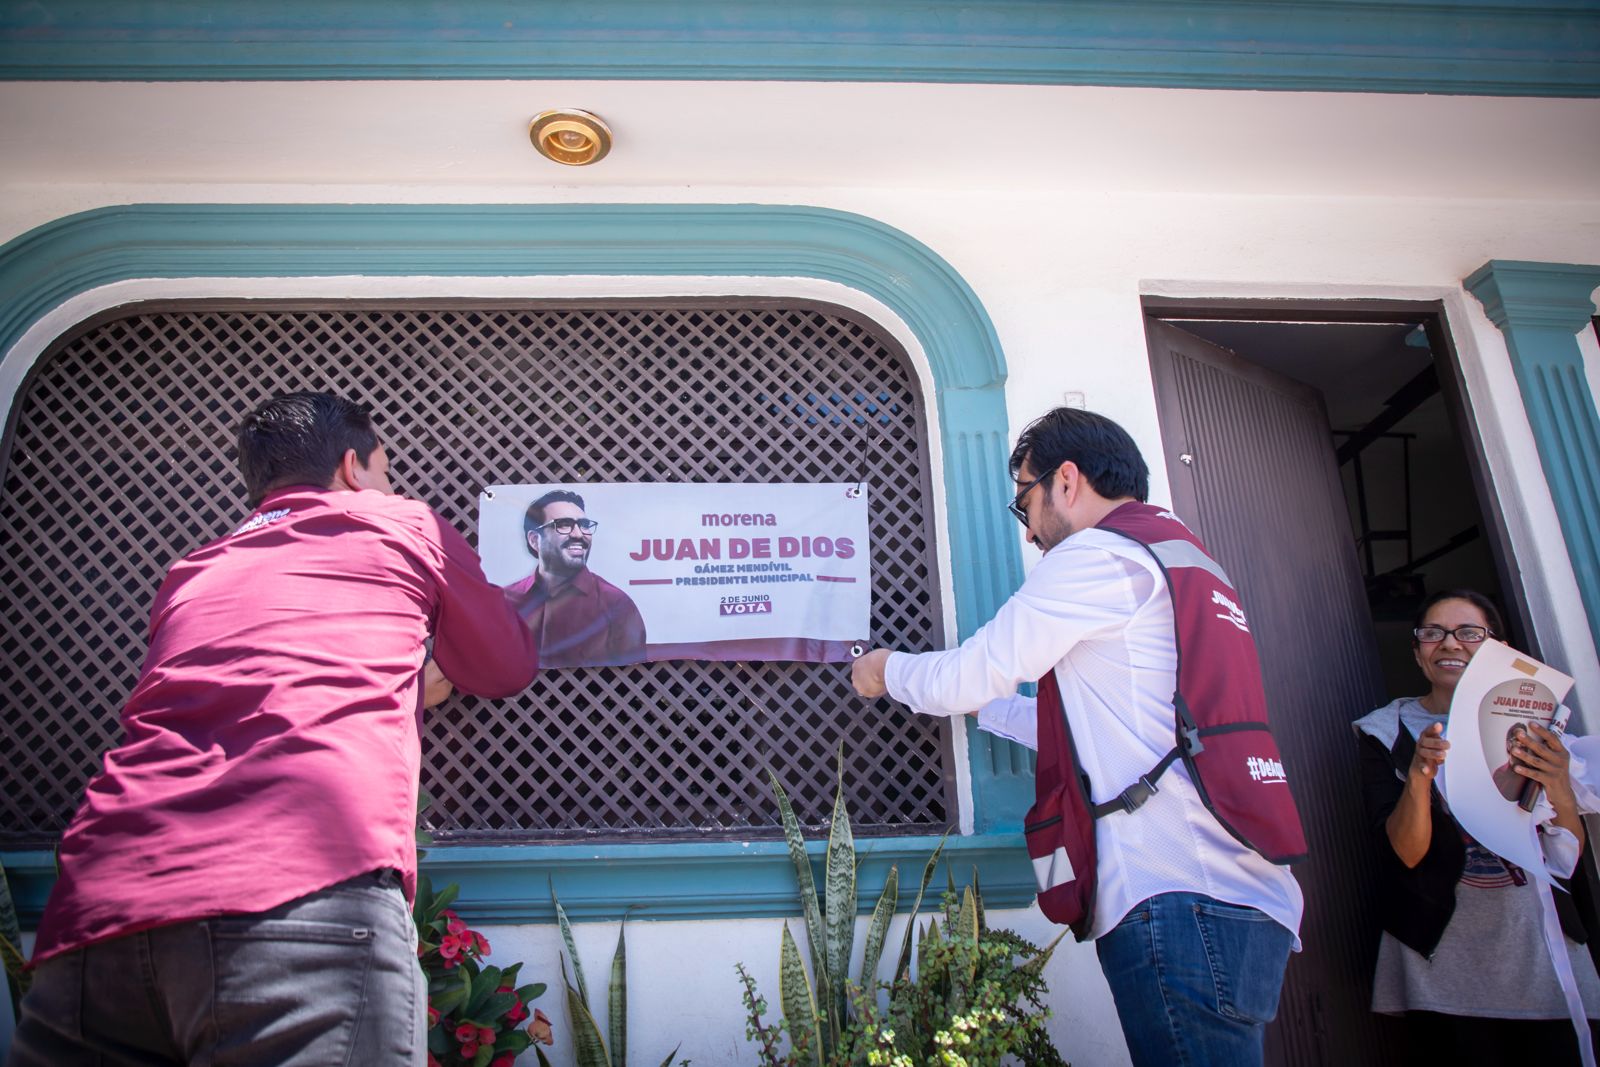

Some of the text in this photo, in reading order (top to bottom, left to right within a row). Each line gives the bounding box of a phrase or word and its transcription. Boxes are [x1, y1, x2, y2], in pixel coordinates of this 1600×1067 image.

[701, 513, 777, 527] morena
[629, 536, 856, 561] JUAN DE DIOS
[694, 561, 792, 574] GÁMEZ MENDÍVIL
[675, 573, 814, 586] PRESIDENTE MUNICIPAL
[720, 594, 770, 604] 2 DE JUNIO
[723, 603, 767, 614] VOTA
[1493, 696, 1518, 708] JUAN
[1519, 699, 1531, 709] DE
[1532, 700, 1554, 712] DIOS
